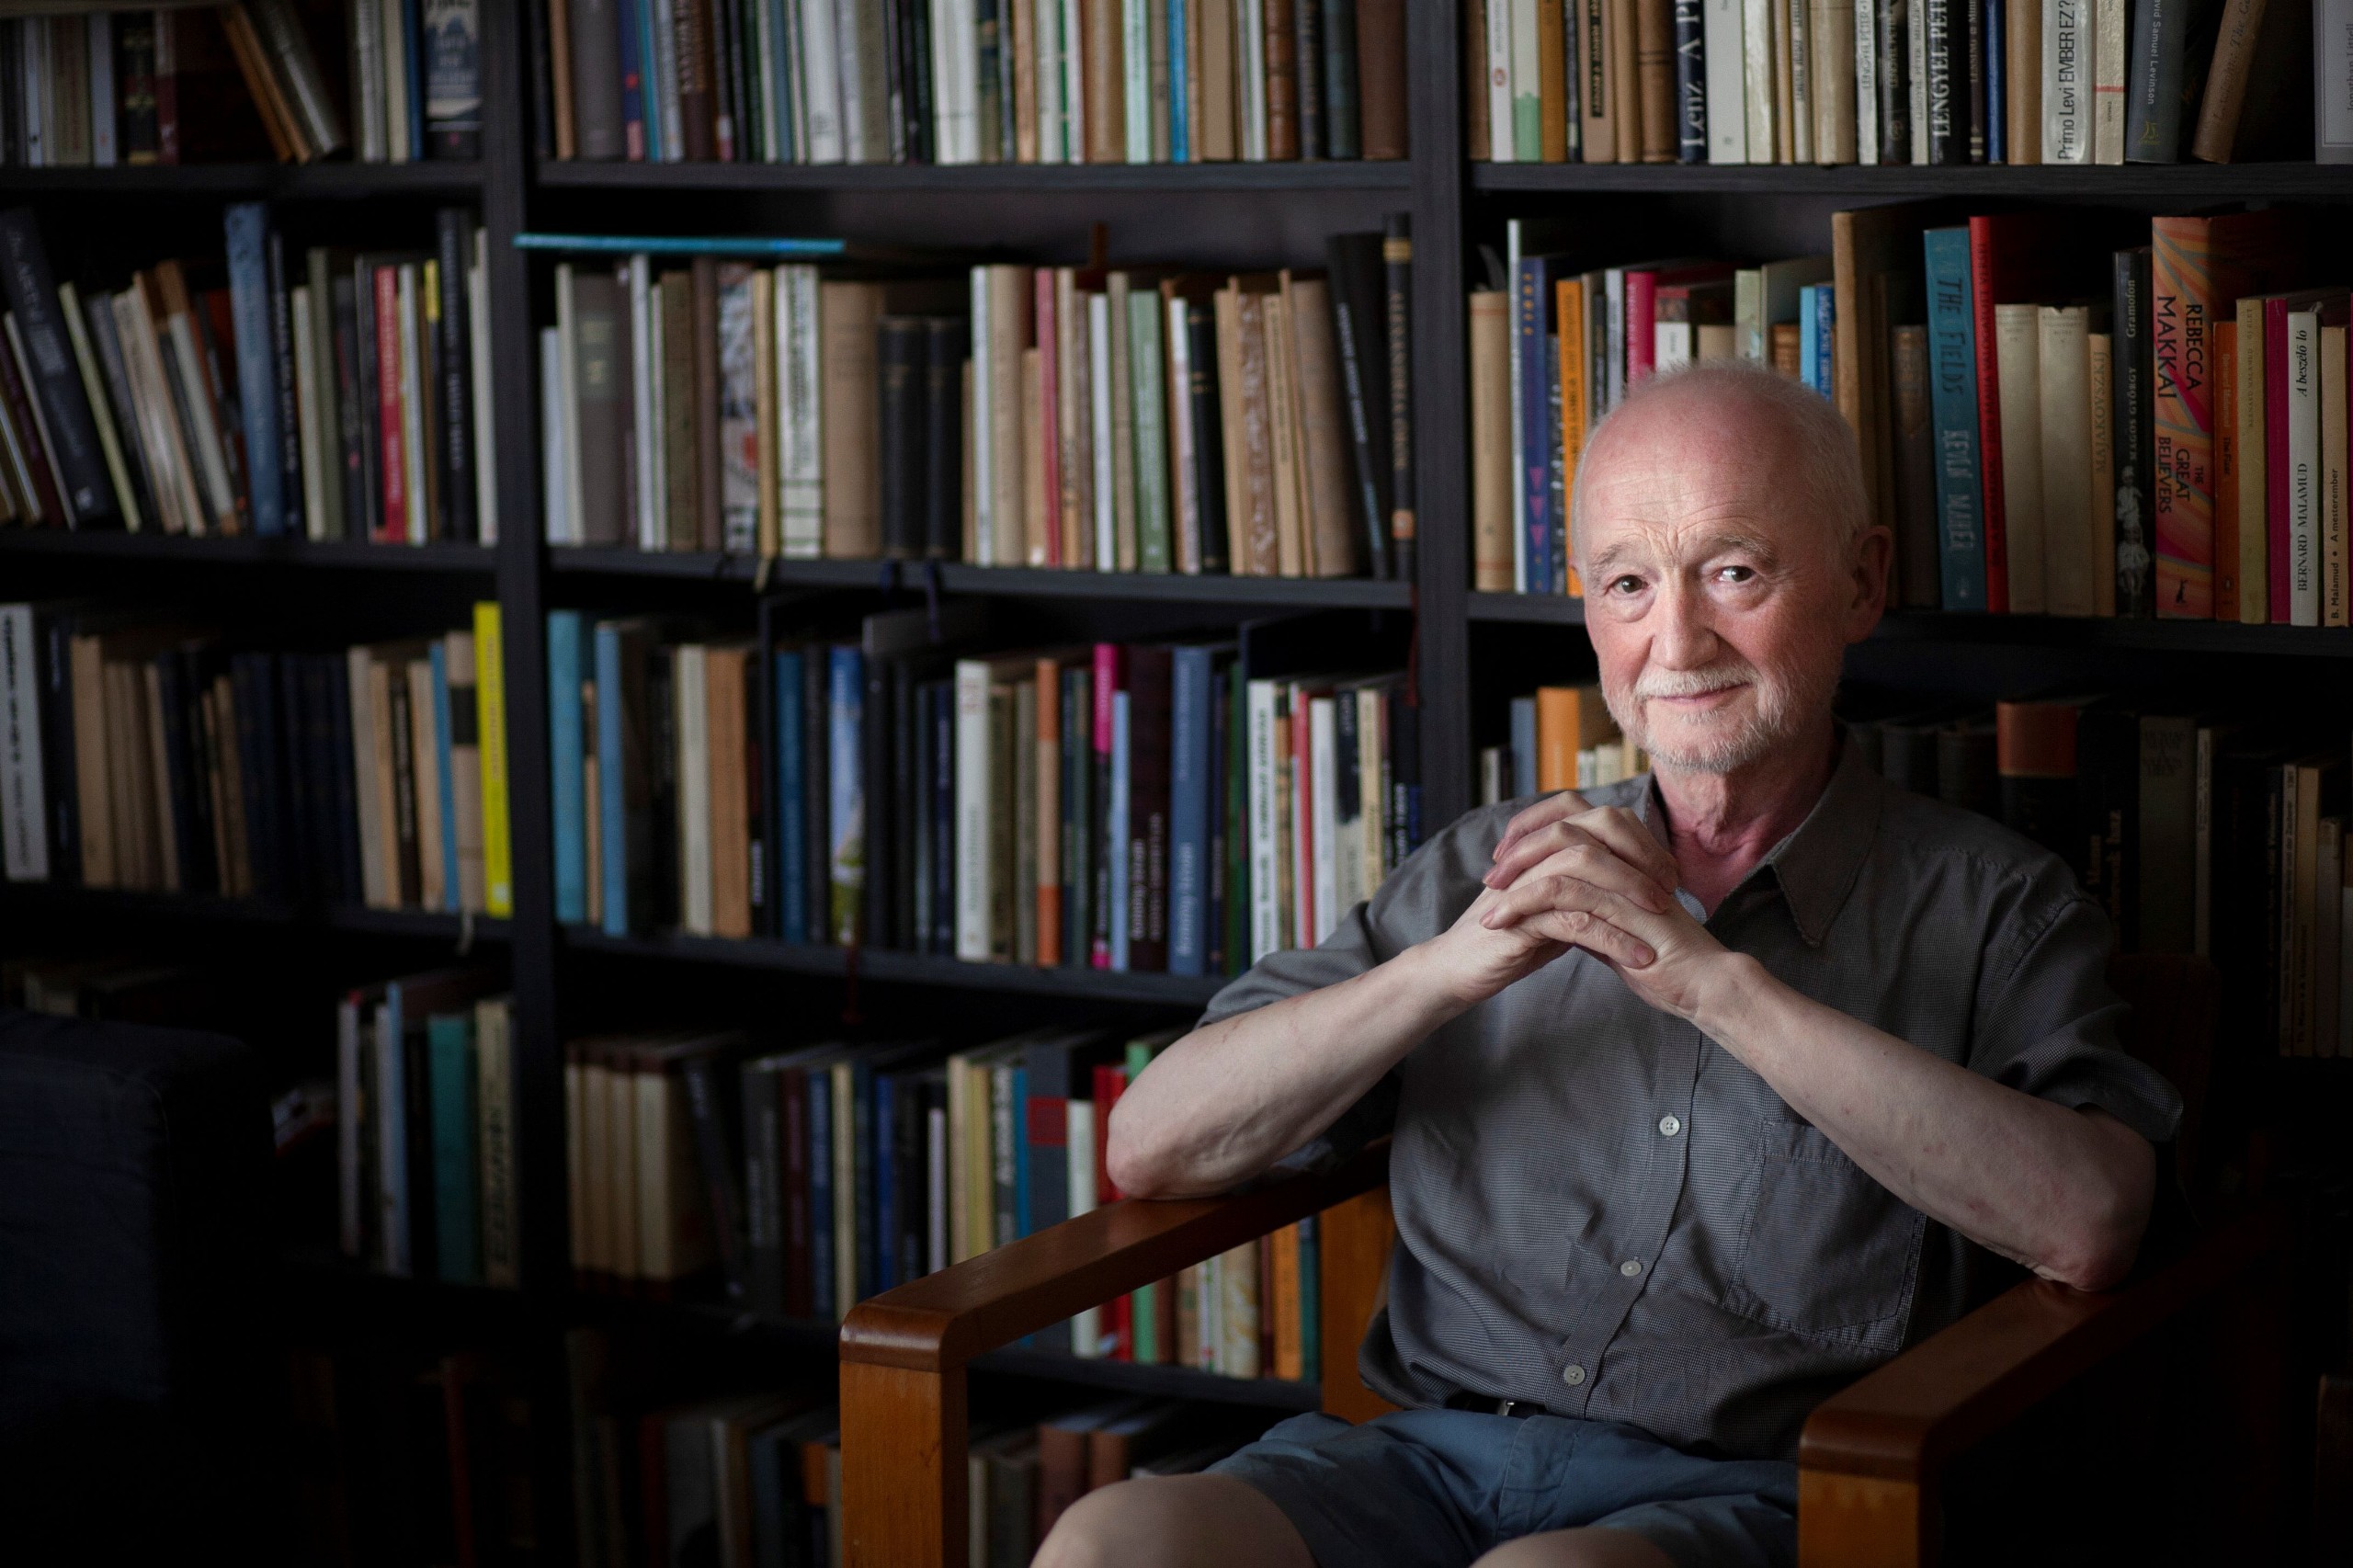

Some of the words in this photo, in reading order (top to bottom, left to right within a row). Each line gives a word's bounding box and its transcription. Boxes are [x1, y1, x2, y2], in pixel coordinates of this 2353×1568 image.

[1927, 0, 1949, 39] PÉT
[2151, 21, 2162, 57] Samuel
[2058, 32, 2075, 83] EMBER
[1930, 45, 1951, 137] LENGYEL
[2058, 87, 2075, 116] Levi
[2147, 61, 2158, 105] Levinson
[2058, 119, 2075, 160] Primo
[1936, 279, 1963, 314] THE
[2125, 279, 2136, 339] Gramofon
[2157, 296, 2177, 398] MAKKAI
[2186, 304, 2203, 391] REBECCA
[2295, 330, 2308, 341] ló
[1938, 331, 1966, 395] FIELDS
[2093, 351, 2109, 472] MAJAKOVSZKIJ
[2296, 386, 2308, 397] A
[2158, 437, 2172, 513] BELIEVERS
[2176, 449, 2190, 502] GREAT
[2195, 466, 2204, 485] THE
[2296, 463, 2308, 528] MALAMUD
[2330, 468, 2338, 531] mesterember
[2330, 534, 2338, 542] A
[2297, 534, 2308, 591] BERNARD
[2330, 562, 2339, 607] Malamud
[2331, 608, 2339, 619] B.
